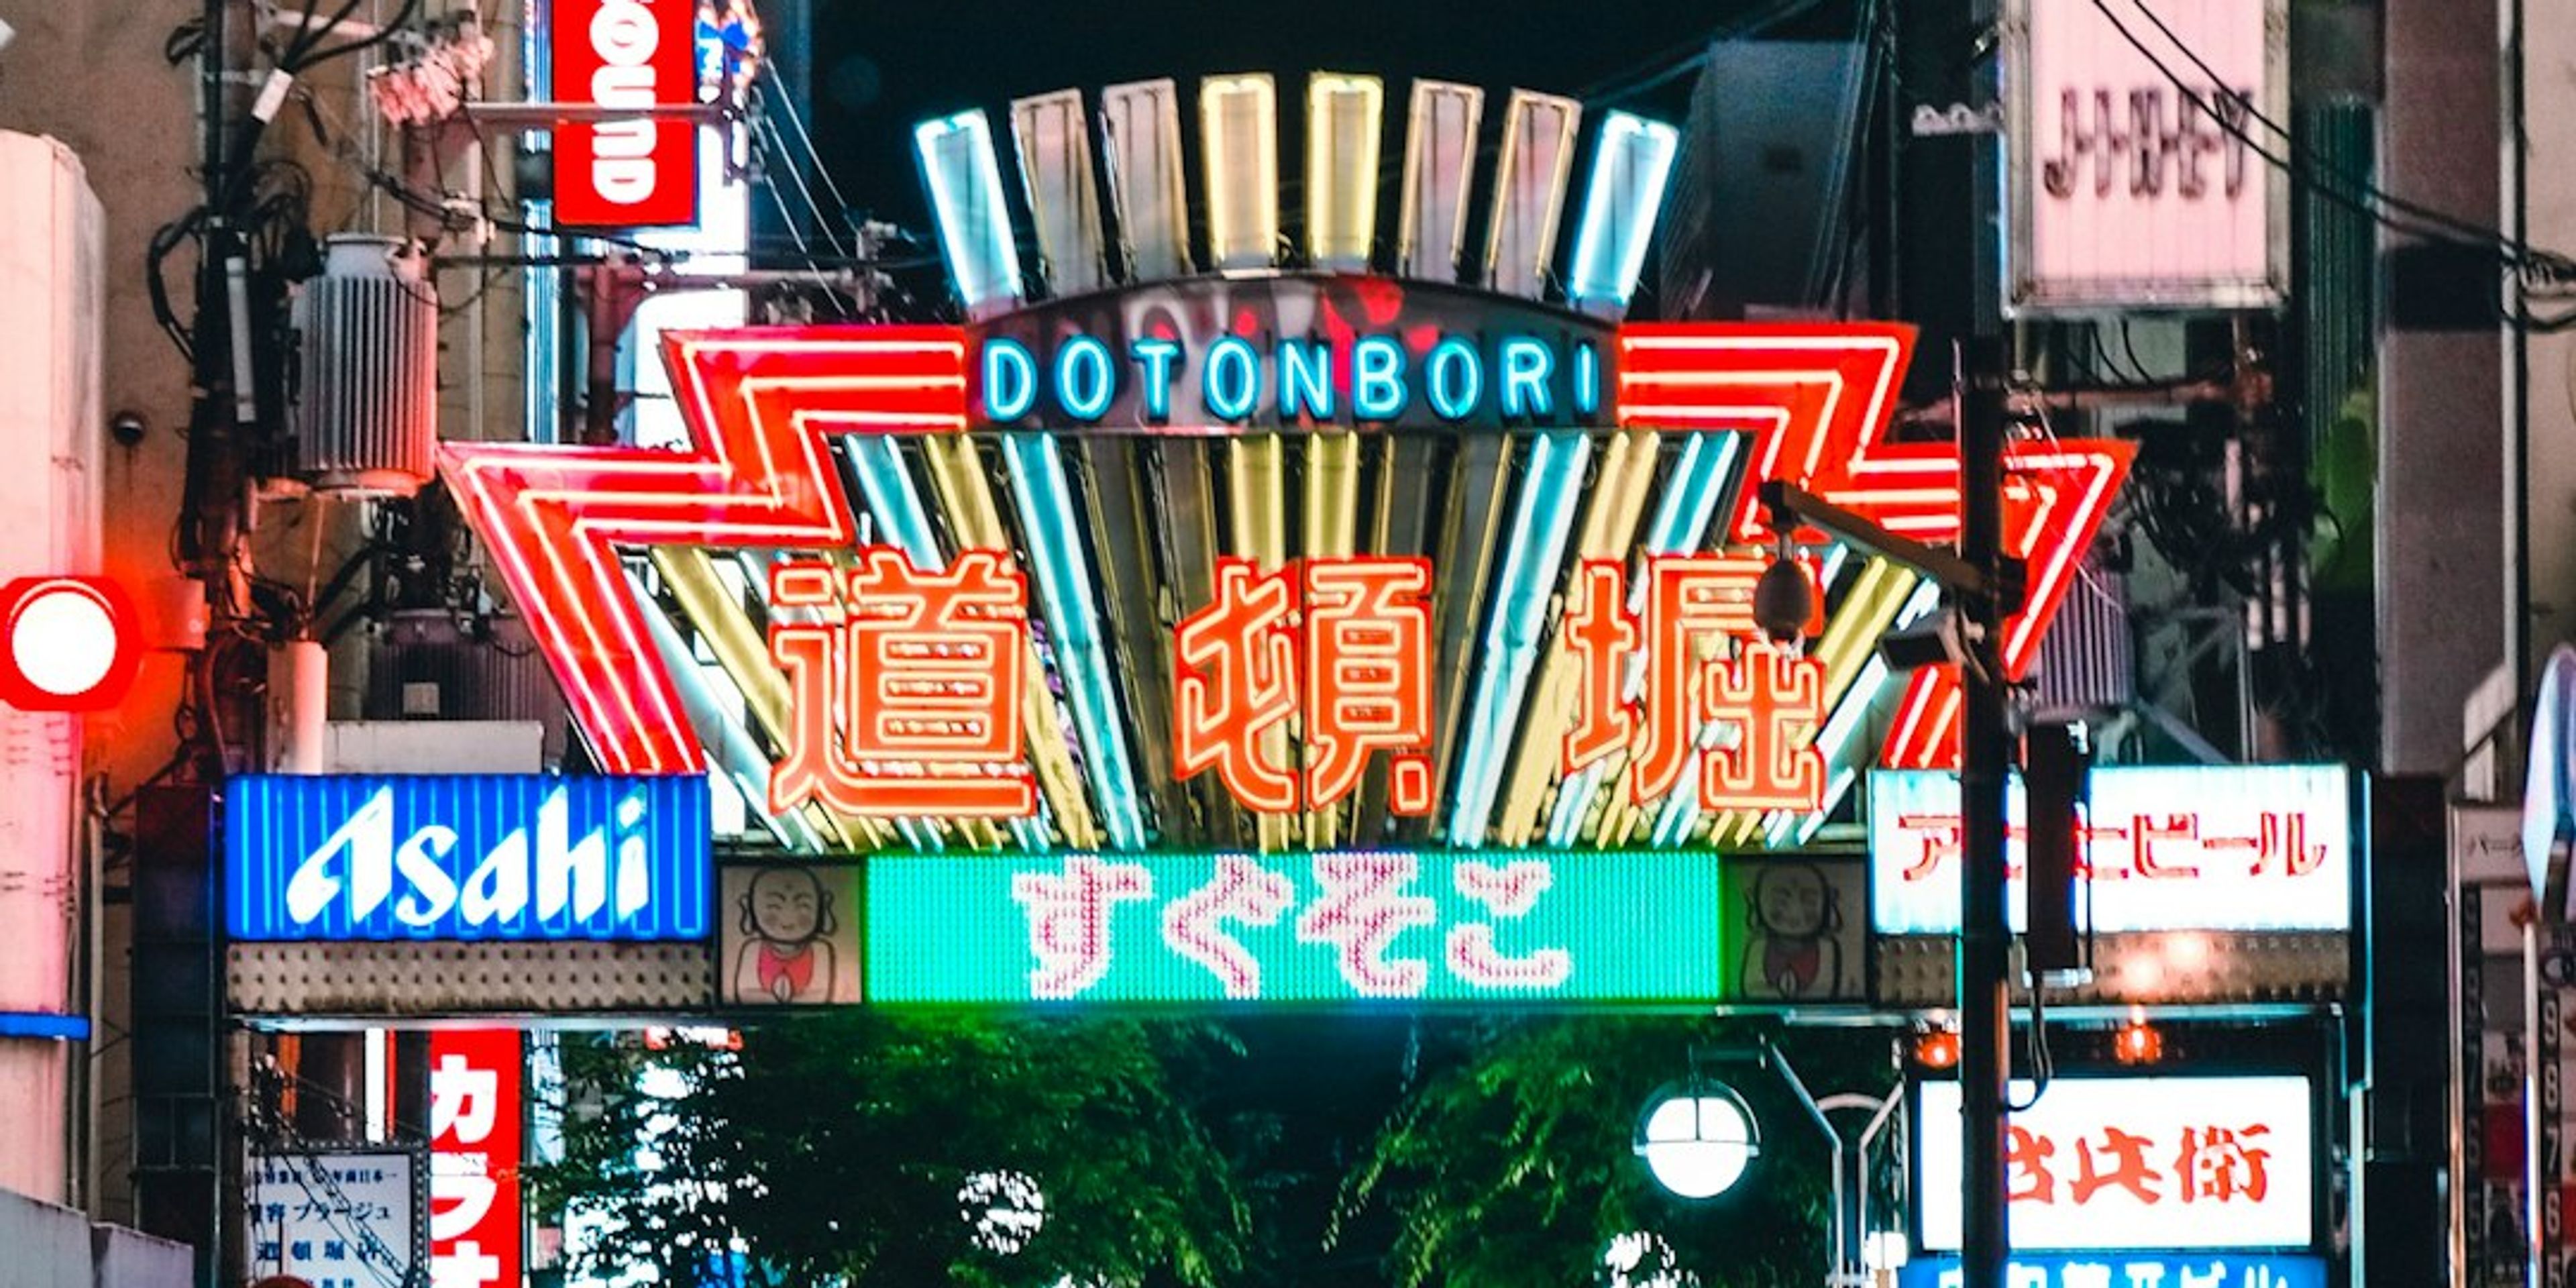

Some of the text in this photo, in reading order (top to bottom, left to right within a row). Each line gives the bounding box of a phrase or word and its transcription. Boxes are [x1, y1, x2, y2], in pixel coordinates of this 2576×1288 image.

[590, 0, 659, 203] OUND
[983, 335, 1601, 424] DOTONBORI
[768, 547, 1829, 816] 道頓堀
[286, 784, 649, 926] Asahi
[1898, 810, 2326, 881] アヒビール
[1012, 852, 1570, 1000] すぐそこ
